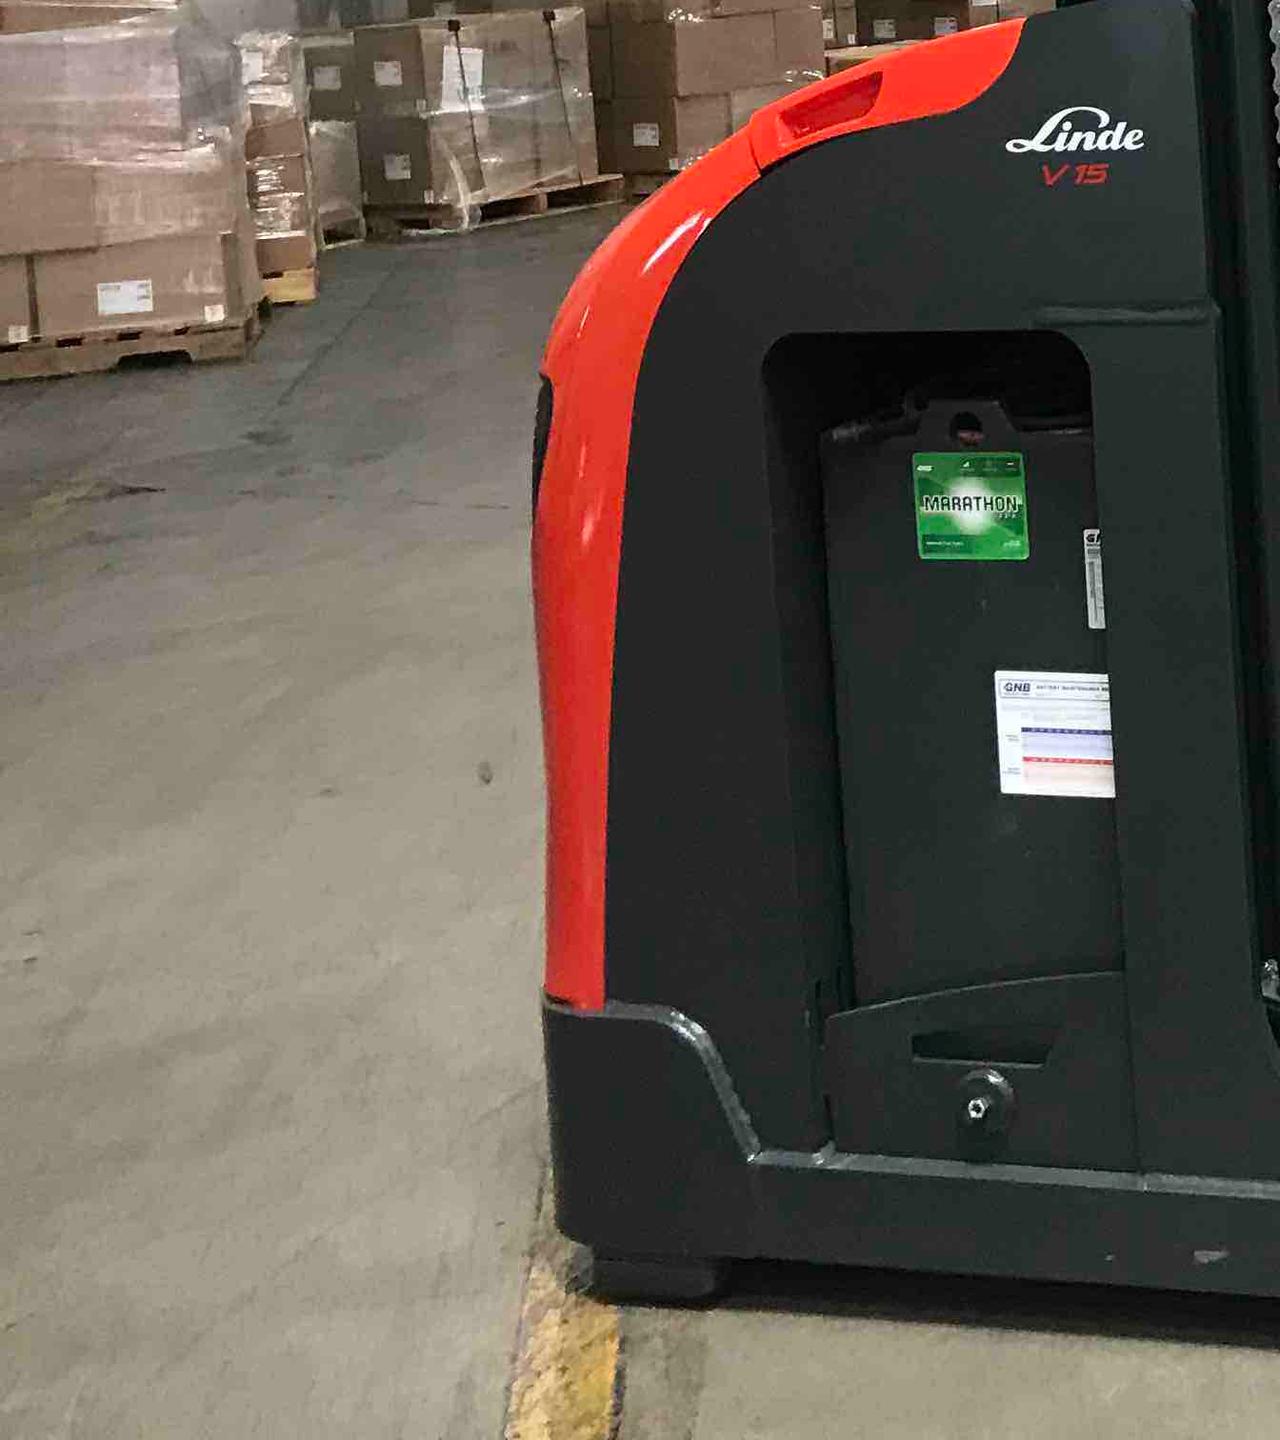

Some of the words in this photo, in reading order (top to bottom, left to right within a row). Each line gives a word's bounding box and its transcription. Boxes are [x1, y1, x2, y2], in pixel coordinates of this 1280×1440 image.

[1005, 106, 1145, 153] Linde
[923, 495, 1018, 512] MARATHON
[1003, 682, 1032, 693] GNB
